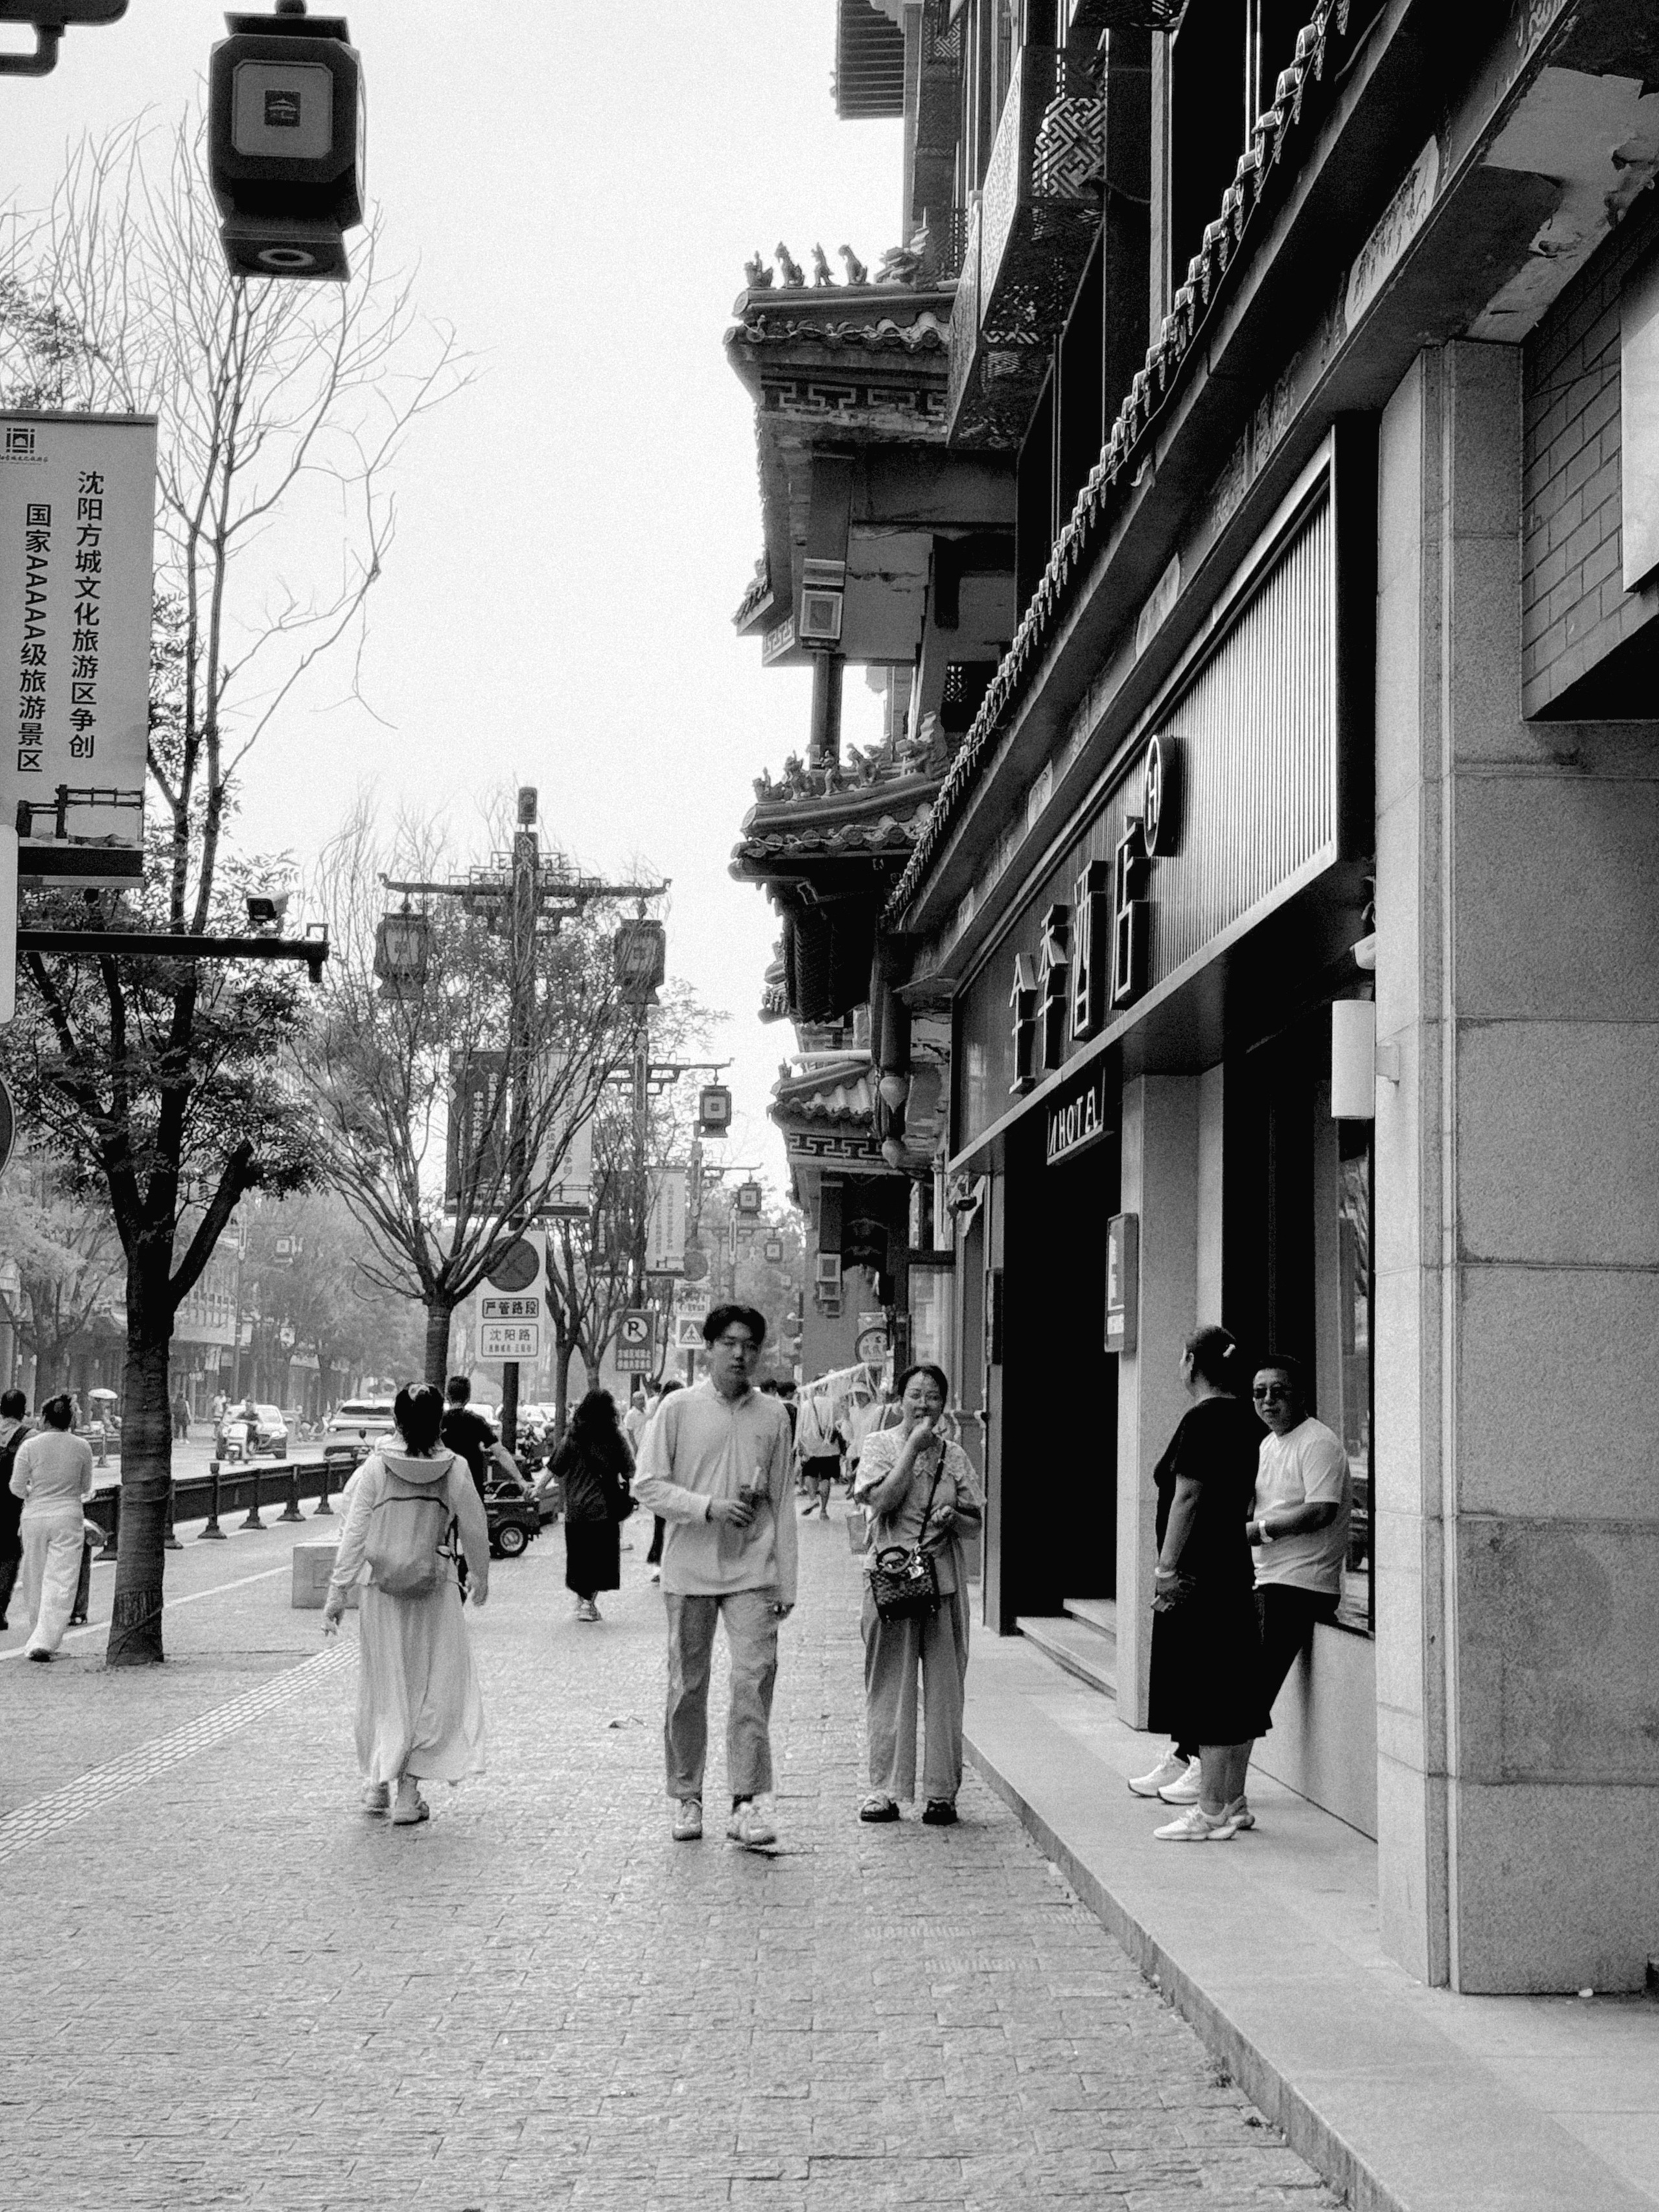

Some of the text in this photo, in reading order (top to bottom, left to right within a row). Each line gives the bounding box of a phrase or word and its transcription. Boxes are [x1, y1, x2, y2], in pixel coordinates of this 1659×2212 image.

[17, 503, 52, 773] 国家AAAAA级旅游景区
[68, 471, 104, 758] 沈阳方城文化旅游区争创
[1009, 815, 1137, 1094] 全季酒店
[485, 1301, 537, 1315] 严管路段
[489, 1328, 531, 1342] 沈阳路
